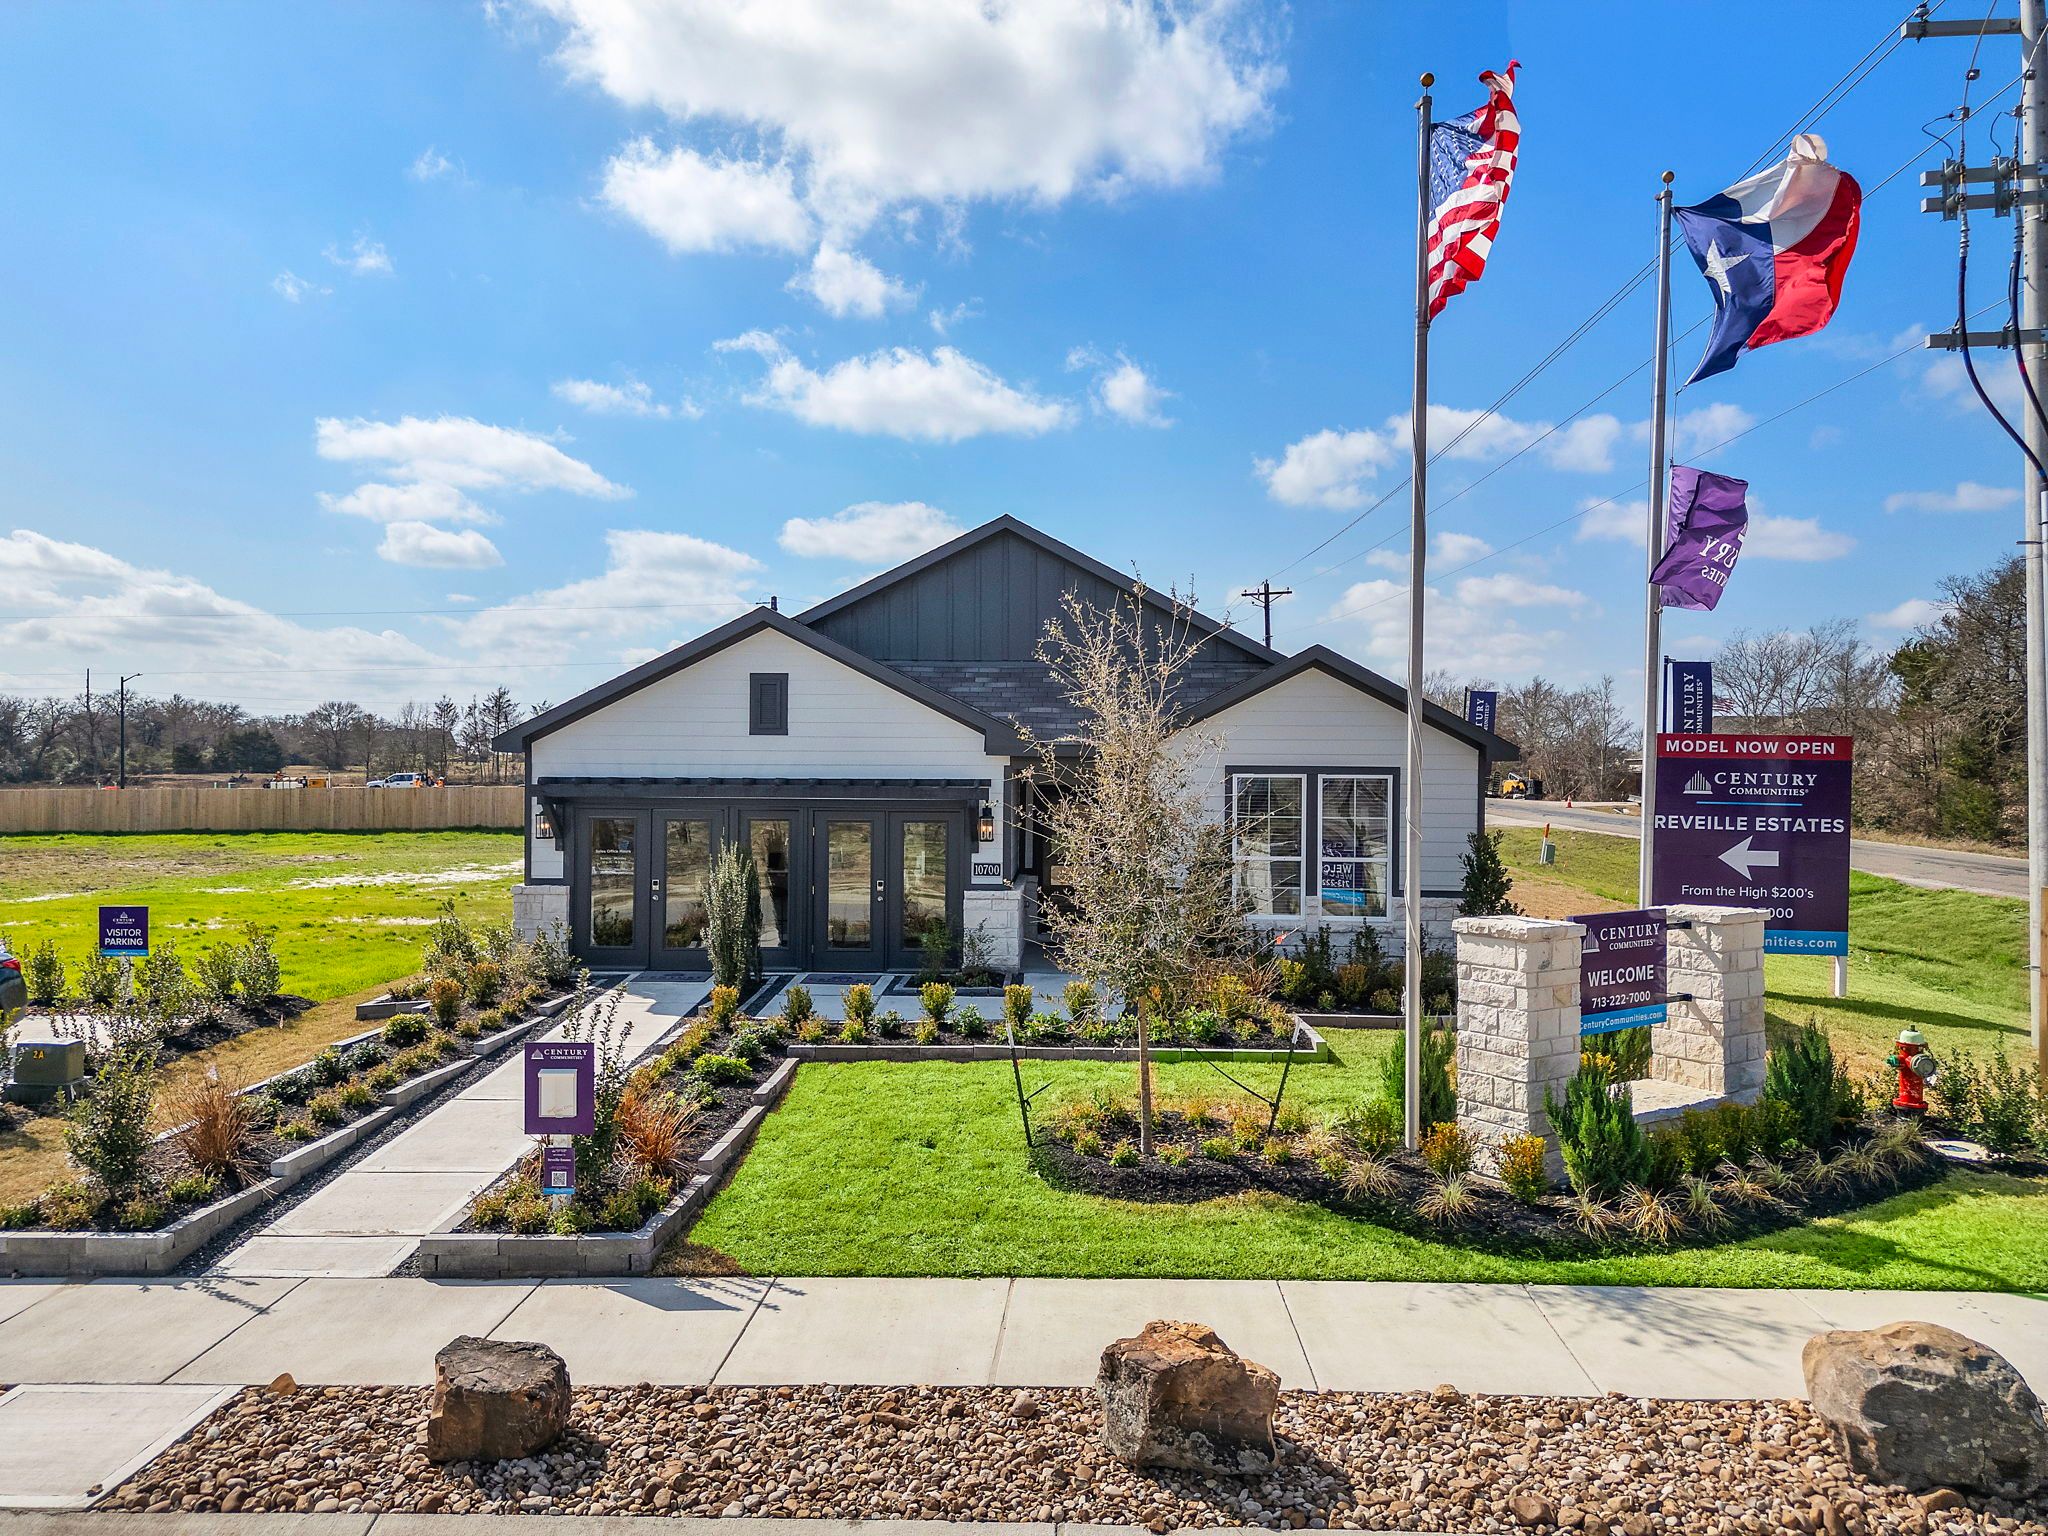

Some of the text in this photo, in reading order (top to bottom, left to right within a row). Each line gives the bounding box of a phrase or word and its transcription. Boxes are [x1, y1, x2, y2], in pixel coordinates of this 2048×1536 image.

[1683, 673, 1694, 734] NTURY
[1666, 740, 1835, 755] MODEL NOW OPEN
[1714, 772, 1818, 786] CENTURY
[1655, 815, 1845, 833] REVEILLE ESTATES
[975, 864, 1000, 875] 10700
[1681, 885, 1814, 900] From the High $200's
[1764, 907, 1794, 919] 000
[106, 928, 141, 936] VISITOR
[1600, 923, 1660, 940] CENTURY
[1587, 964, 1654, 988] WELCOME
[1591, 990, 1651, 1009] 713-222-7000
